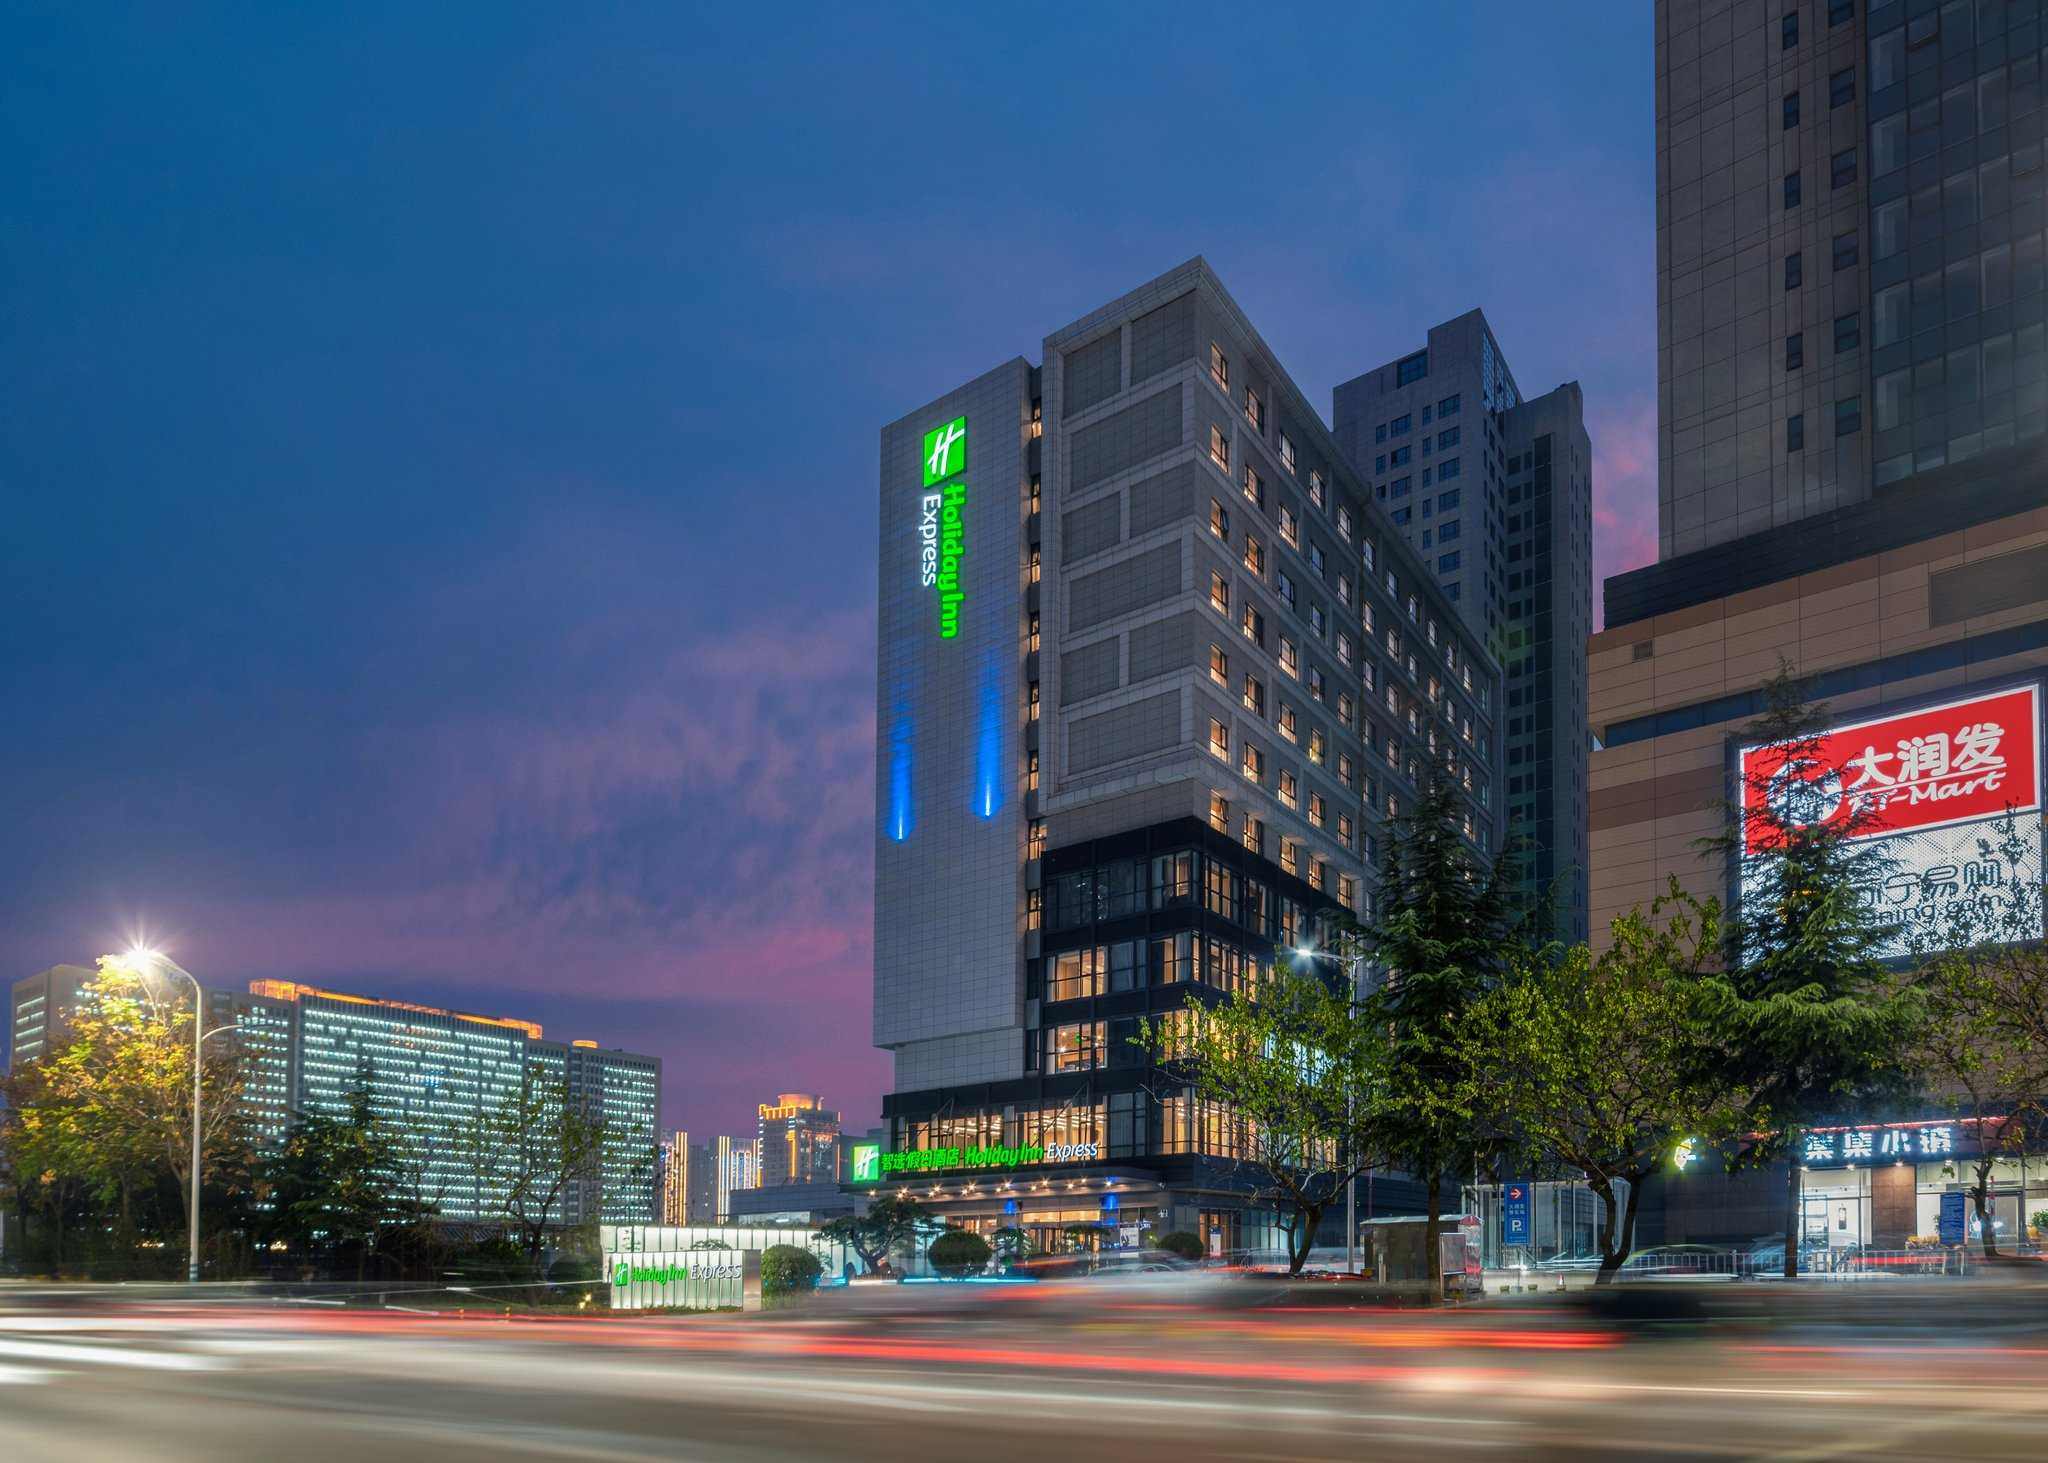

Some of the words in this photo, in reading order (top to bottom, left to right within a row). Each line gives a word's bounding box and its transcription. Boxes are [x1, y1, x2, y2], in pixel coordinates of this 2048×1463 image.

[919, 493, 941, 587] Express
[936, 484, 966, 590] Holiday
[941, 592, 966, 639] Inn
[1847, 722, 2005, 786] 大润发
[965, 1143, 1019, 1168] Holiday
[1020, 1141, 1044, 1162] Inn
[1047, 1142, 1098, 1162] Express
[632, 1265, 669, 1286] Holiday
[668, 1263, 688, 1281] Inn
[691, 1263, 743, 1284] Express
